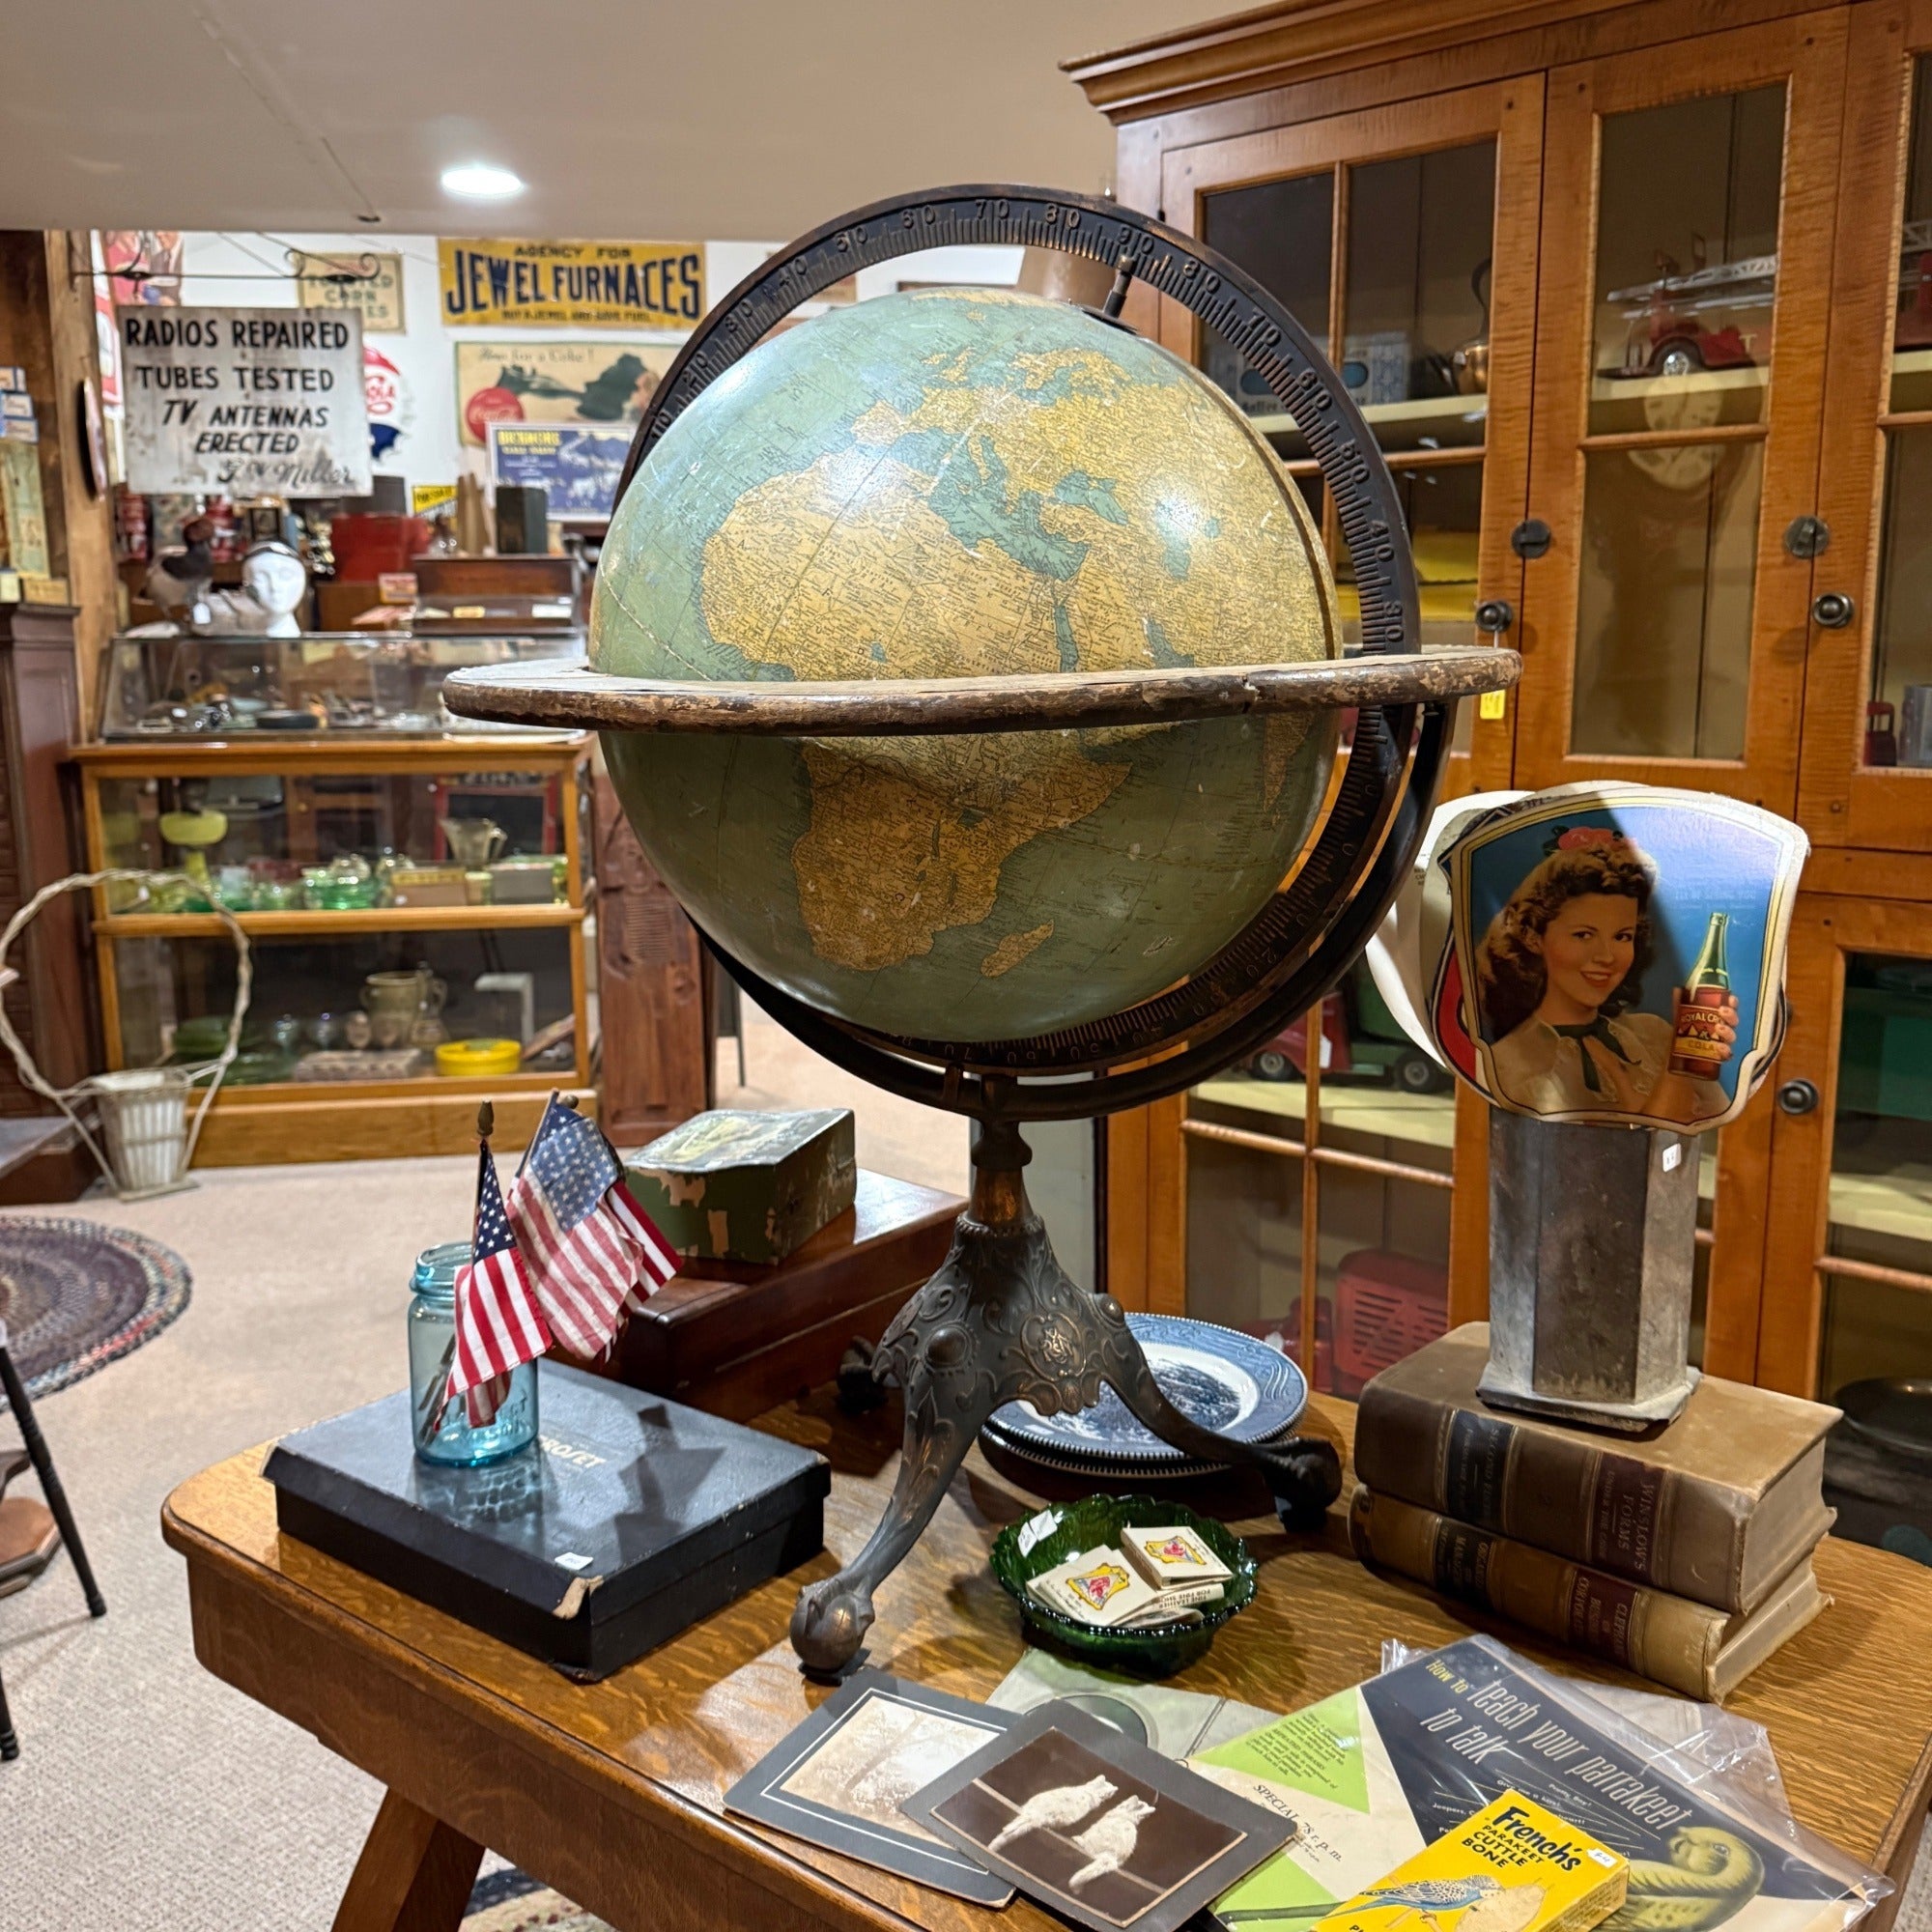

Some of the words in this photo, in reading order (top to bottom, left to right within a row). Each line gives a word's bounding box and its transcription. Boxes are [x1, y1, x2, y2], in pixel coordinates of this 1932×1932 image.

[515, 245, 583, 259] AGENCY
[597, 245, 632, 260] FOR
[447, 248, 546, 315] JEWEL
[553, 253, 700, 321] FURNACES
[127, 318, 218, 349] RADIOS
[232, 320, 350, 351] REPAIRED
[136, 365, 219, 390] TUBES
[233, 366, 334, 392] TESTED
[161, 398, 198, 426] TV
[209, 405, 329, 429] ANTENNAS
[195, 432, 300, 454] ERECTED
[1688, 1038, 1715, 1052] COLA
[1618, 1493, 1636, 1551] FORMS
[1634, 1484, 1656, 1572] WINSLOW'S
[1419, 1707, 1463, 1733] to
[1445, 1724, 1510, 1765] talk
[1467, 1679, 1542, 1731] teach
[1517, 1719, 1590, 1762] your
[1564, 1754, 1693, 1832] parrakeet
[1253, 1784, 1300, 1820] SPECIAL
[1461, 1837, 1510, 1869] BONE
[1472, 1831, 1529, 1868] CUTTLE
[1482, 1824, 1546, 1864] PARAKEET
[1491, 1805, 1583, 1872] French's
